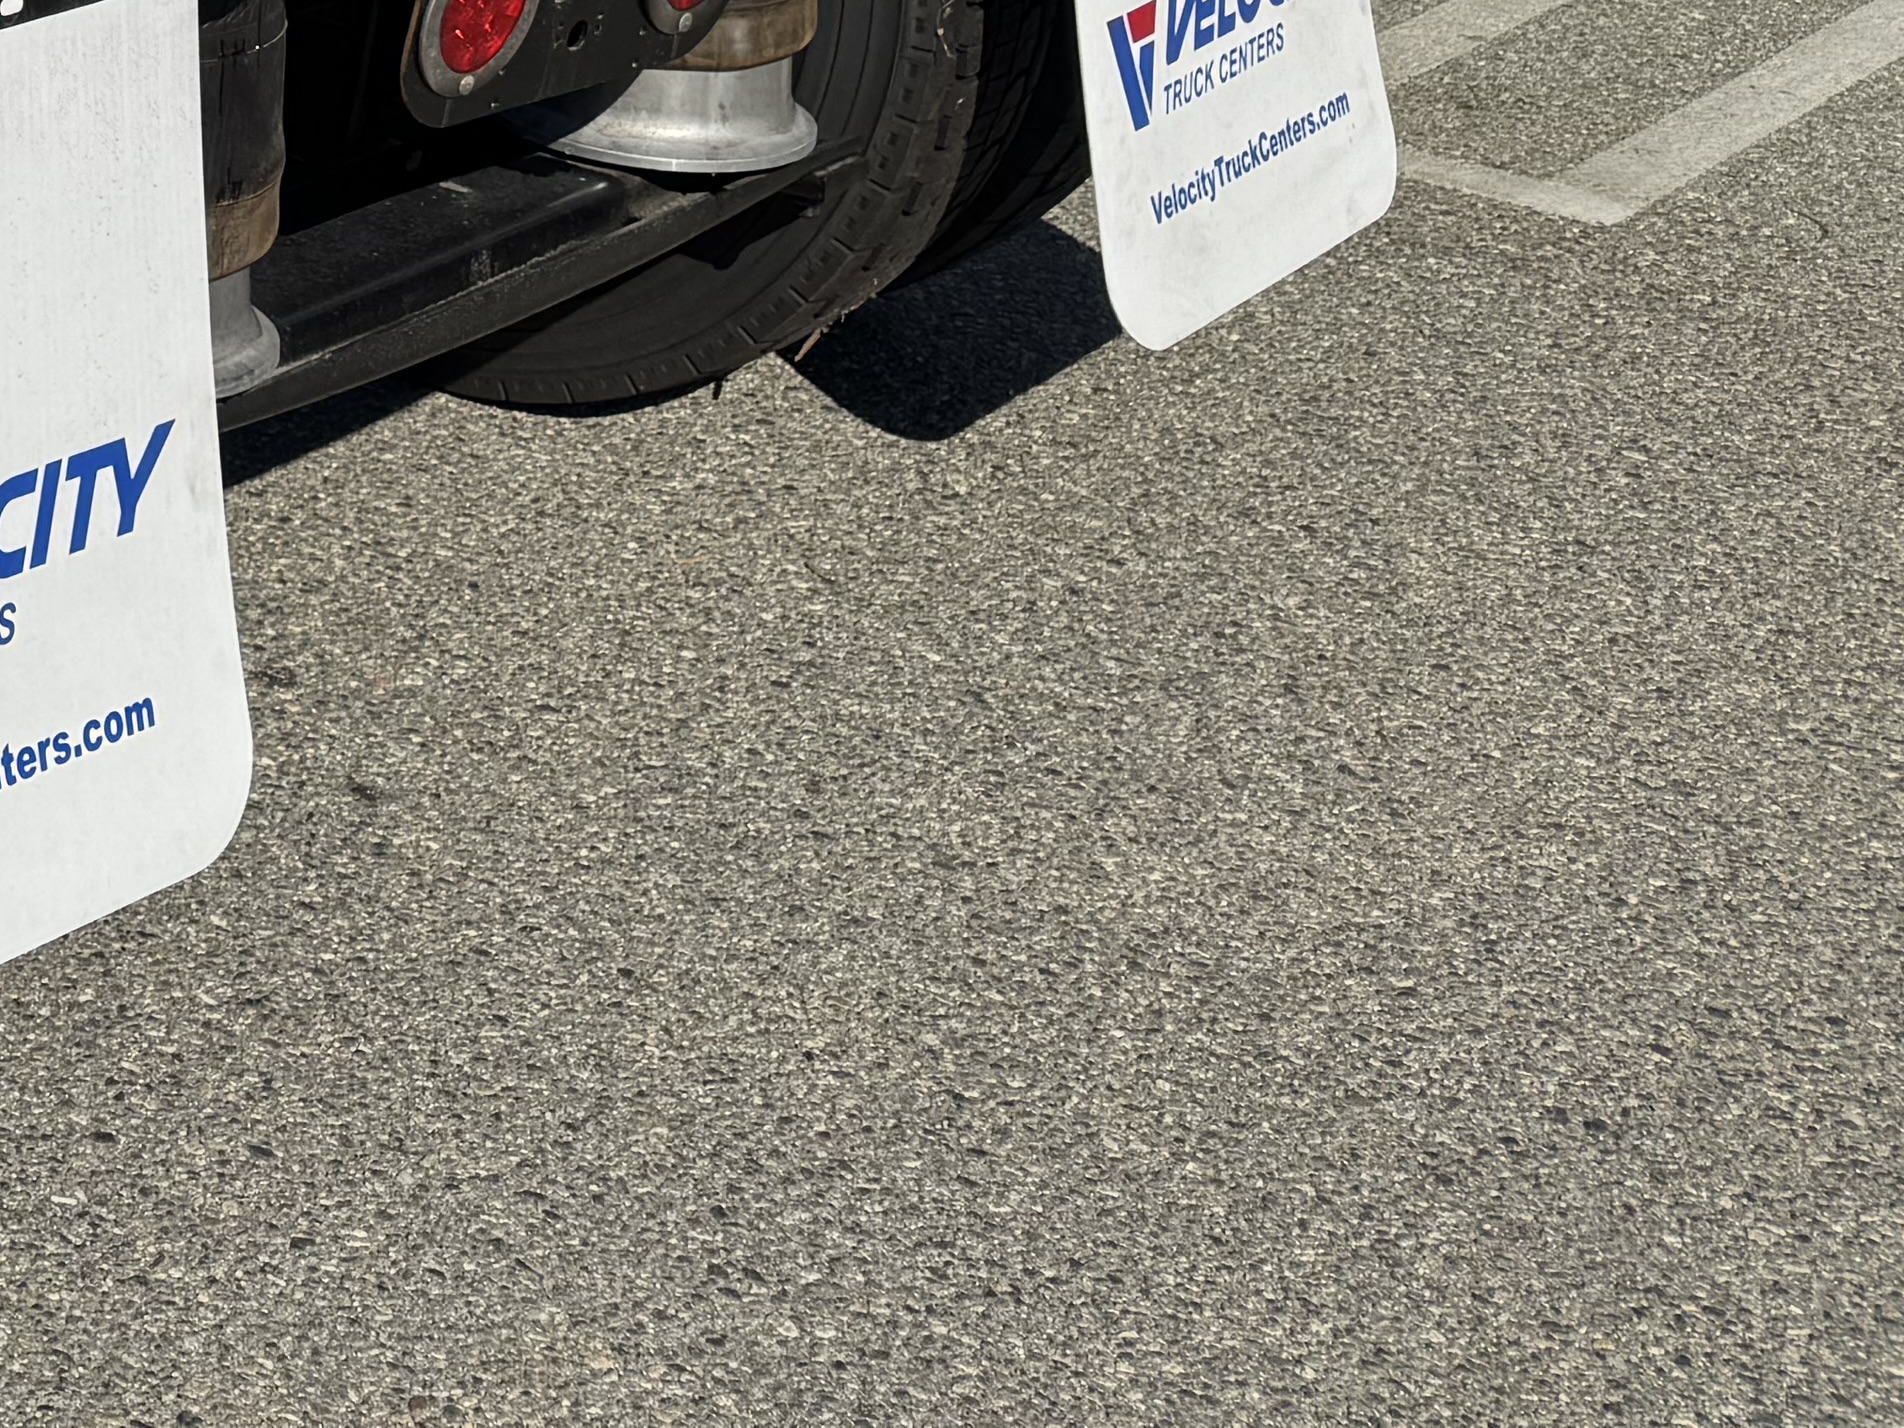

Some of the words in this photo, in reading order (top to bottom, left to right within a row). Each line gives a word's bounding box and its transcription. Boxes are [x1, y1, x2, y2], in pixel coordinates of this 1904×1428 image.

[1164, 57, 1215, 115] TRUCK
[1219, 22, 1285, 85] CENTERS
[1150, 91, 1351, 225] VelocityTruckCenters.com
